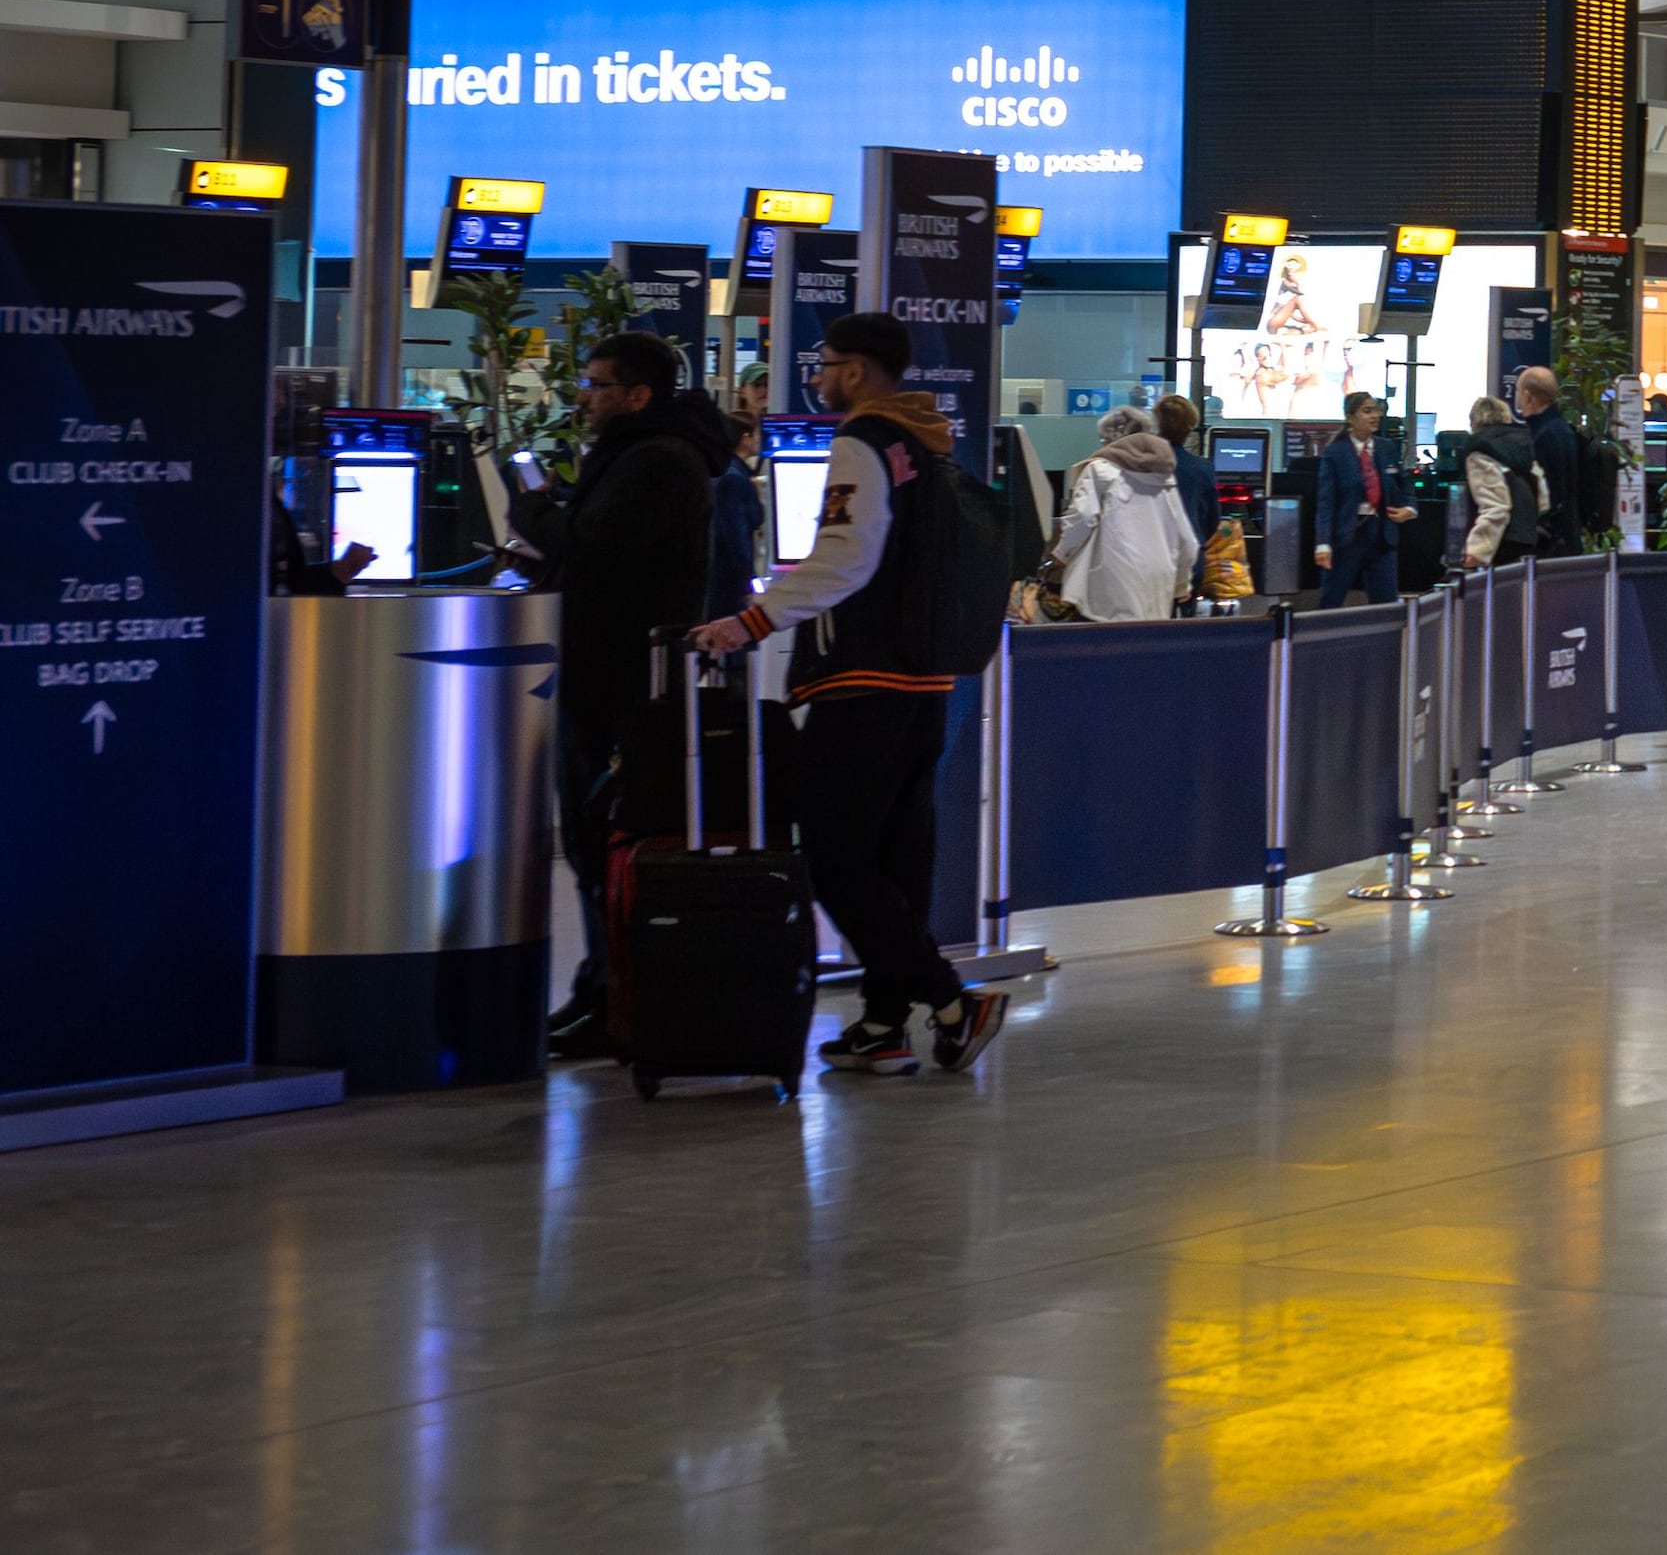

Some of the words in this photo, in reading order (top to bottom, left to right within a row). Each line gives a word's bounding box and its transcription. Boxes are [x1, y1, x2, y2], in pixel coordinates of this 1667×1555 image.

[533, 52, 580, 105] in
[593, 49, 786, 103] tickets.
[1013, 151, 1040, 172] to
[1043, 149, 1143, 177] possible
[898, 213, 959, 236] BRITISH
[894, 237, 959, 260] AIRWAYS
[798, 272, 847, 288] BRITISH
[0, 306, 69, 334] TISH
[72, 308, 195, 337] AIRWAYS
[892, 296, 987, 324] CHECK-IN
[60, 417, 122, 443] Zone
[126, 417, 148, 442] A
[8, 460, 76, 485] CLUB
[79, 460, 192, 484] CHECK-IN
[60, 577, 121, 603] Zone
[125, 576, 144, 601] B
[55, 620, 113, 644] SELF
[116, 615, 206, 642] SERVICE
[37, 662, 89, 687] BAG
[93, 658, 160, 684] DROP
